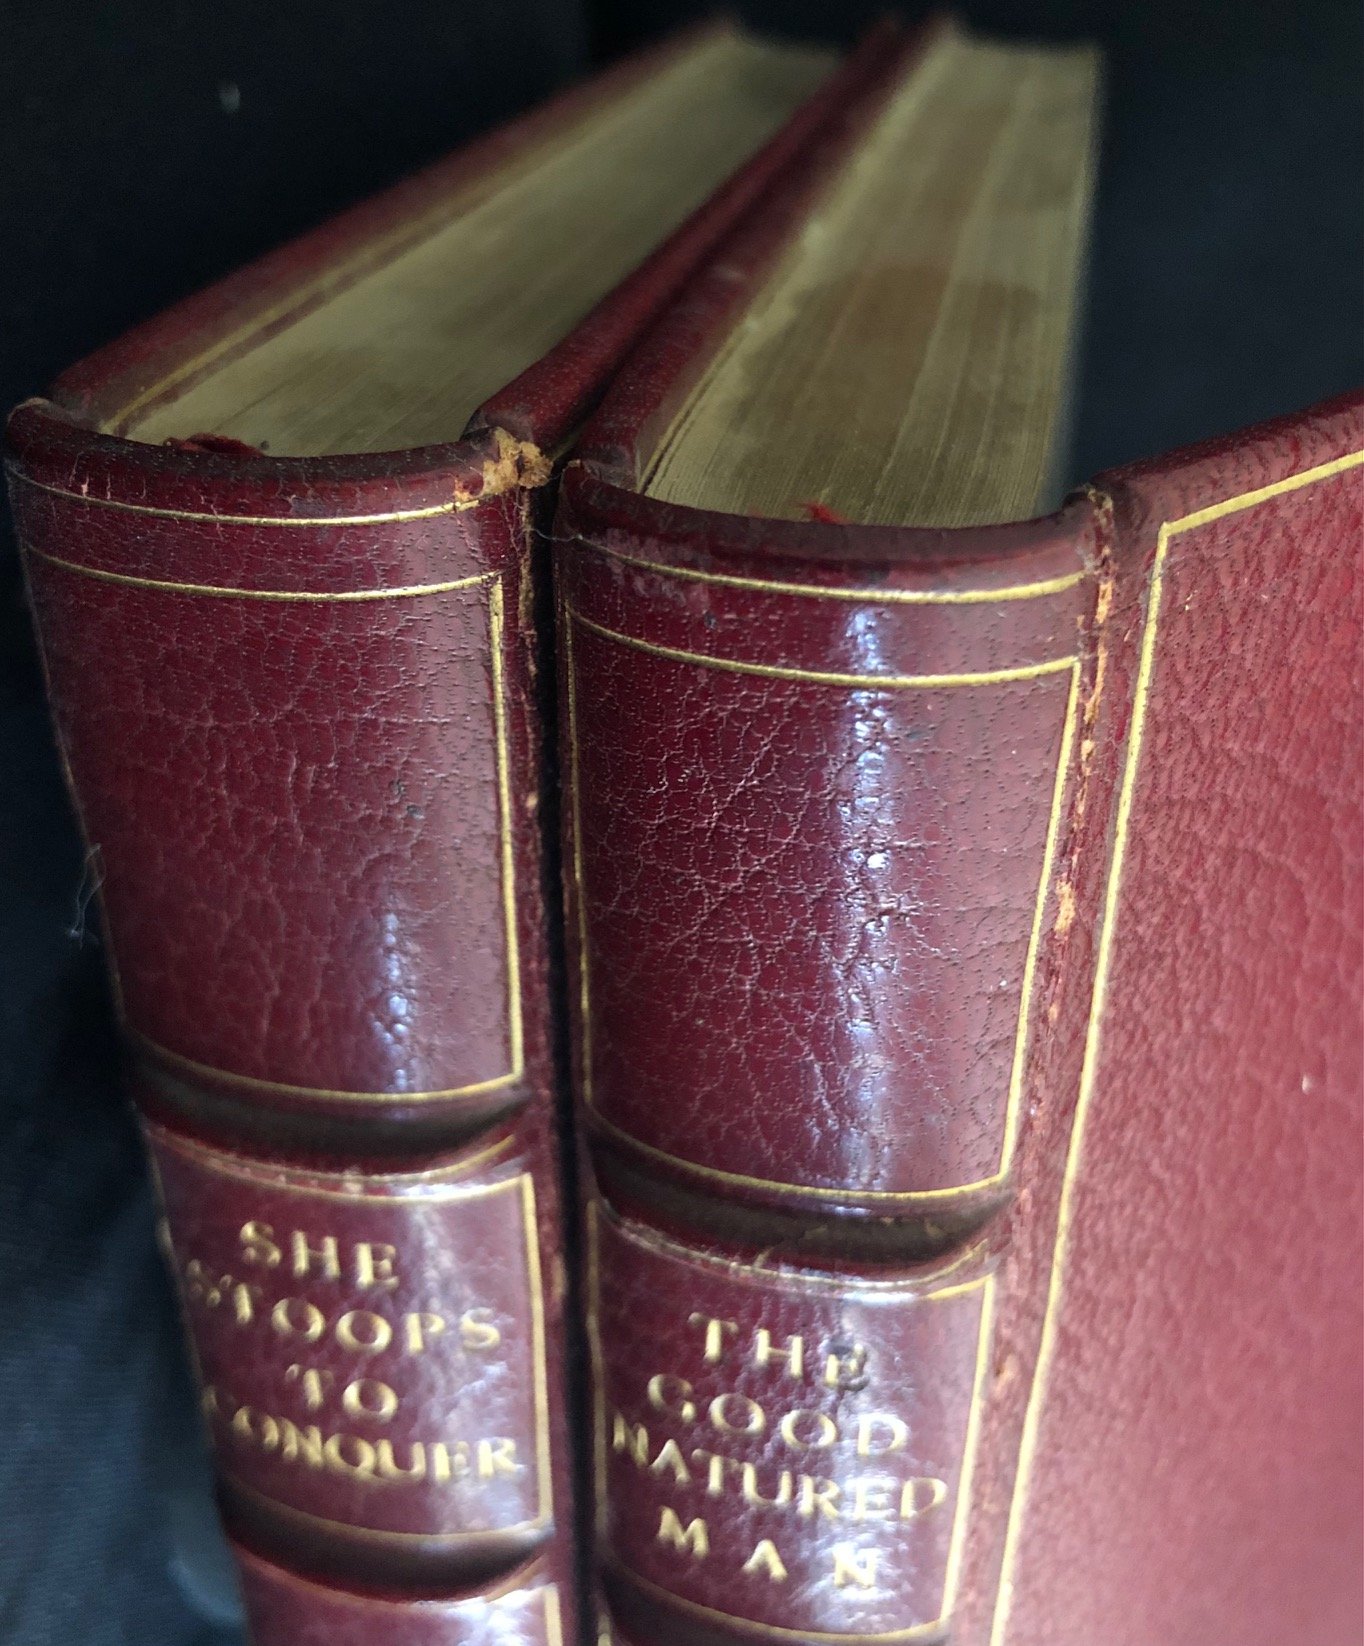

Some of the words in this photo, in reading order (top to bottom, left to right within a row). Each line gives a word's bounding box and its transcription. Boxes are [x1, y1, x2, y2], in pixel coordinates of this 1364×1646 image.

[240, 1219, 398, 1290] SHE
[688, 1311, 869, 1391] THE
[284, 1363, 398, 1424] TO
[647, 1373, 910, 1457] GOOD
[613, 1413, 949, 1521] NATURED
[657, 1505, 880, 1588] MAN
